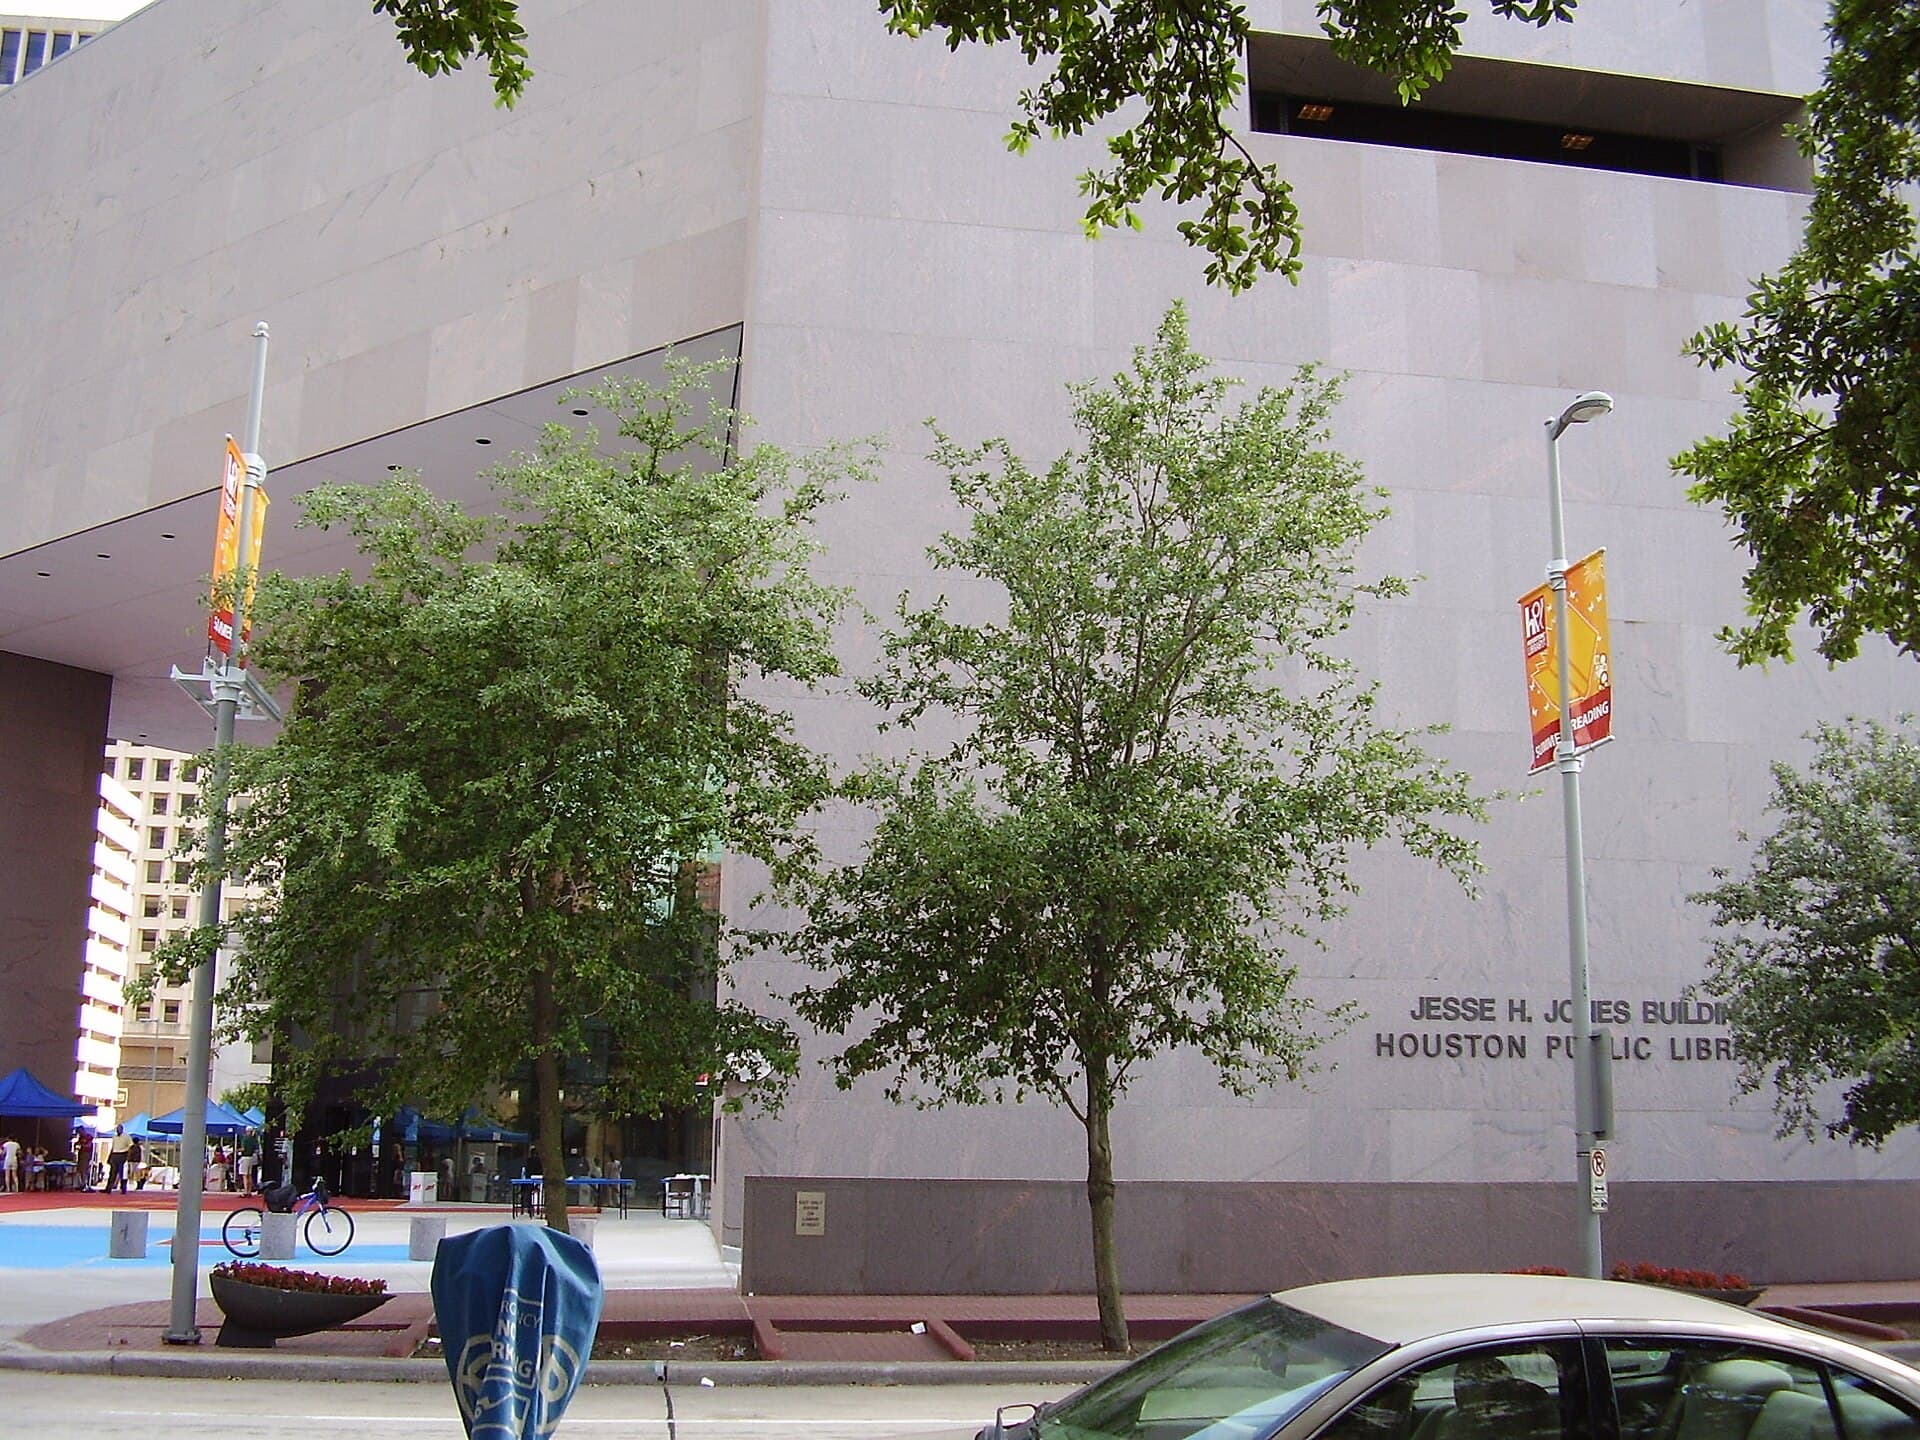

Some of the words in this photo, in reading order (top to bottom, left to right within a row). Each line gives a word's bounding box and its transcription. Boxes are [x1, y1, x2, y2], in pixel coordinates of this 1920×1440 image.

[1410, 996, 1496, 1022] JESSE
[1508, 999, 1533, 1023] H.
[1543, 999, 1632, 1025] JOES
[1375, 1032, 1527, 1059] HOUSTON
[1546, 1035, 1652, 1061] PLIC
